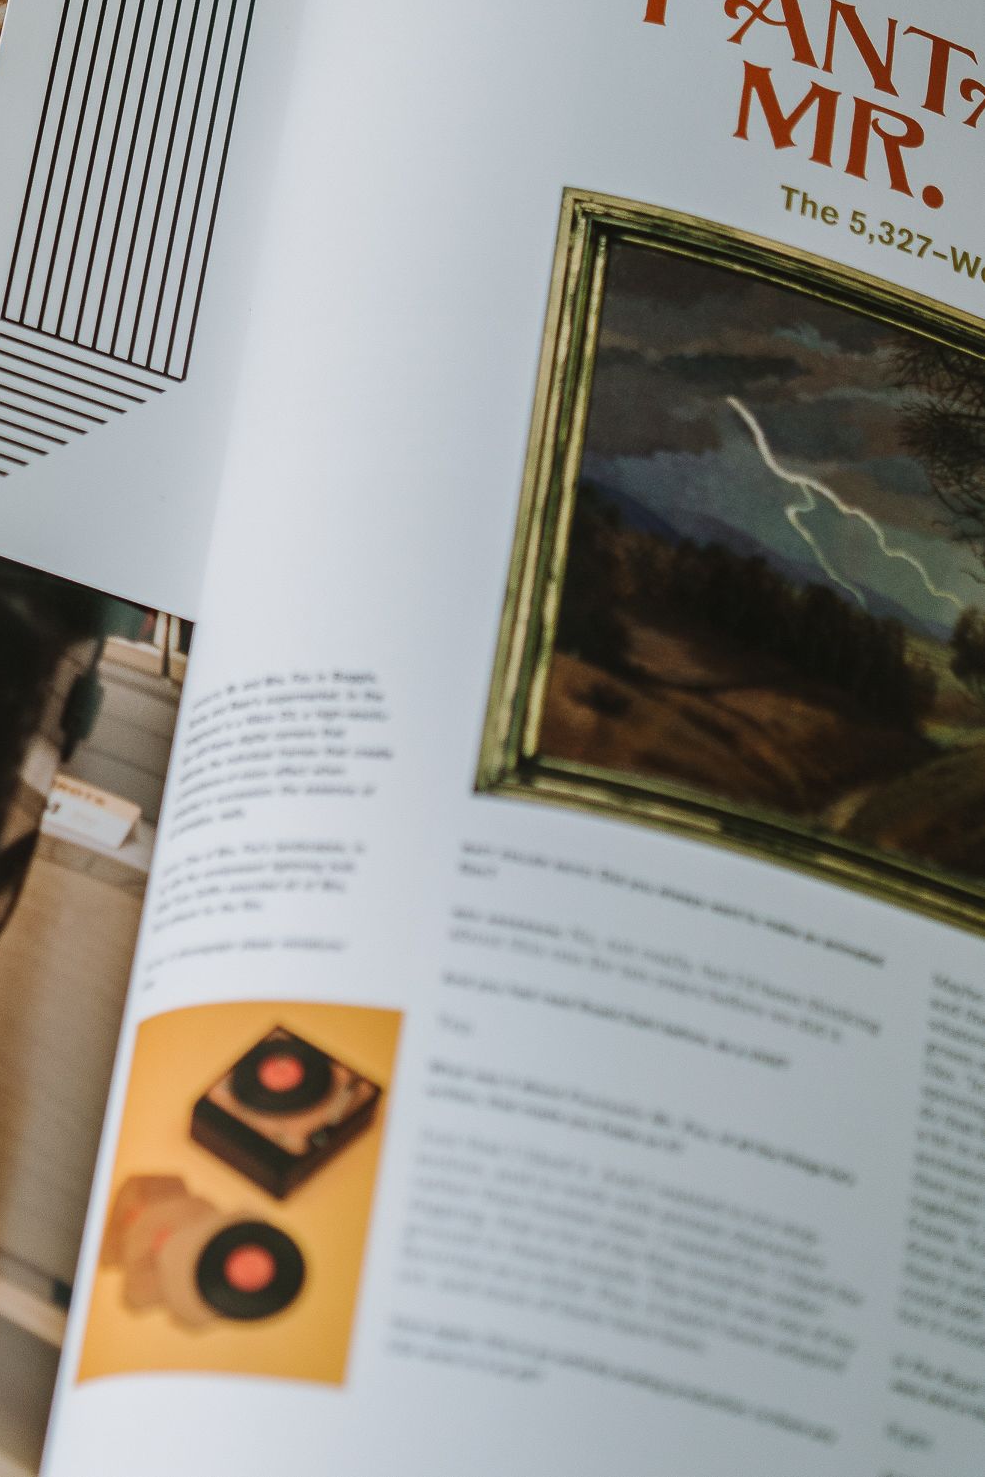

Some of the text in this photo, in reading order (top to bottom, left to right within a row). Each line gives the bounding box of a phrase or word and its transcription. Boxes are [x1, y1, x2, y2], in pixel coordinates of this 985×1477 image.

[733, 60, 945, 210] MR.
[781, 184, 985, 285] The 5,327-W
